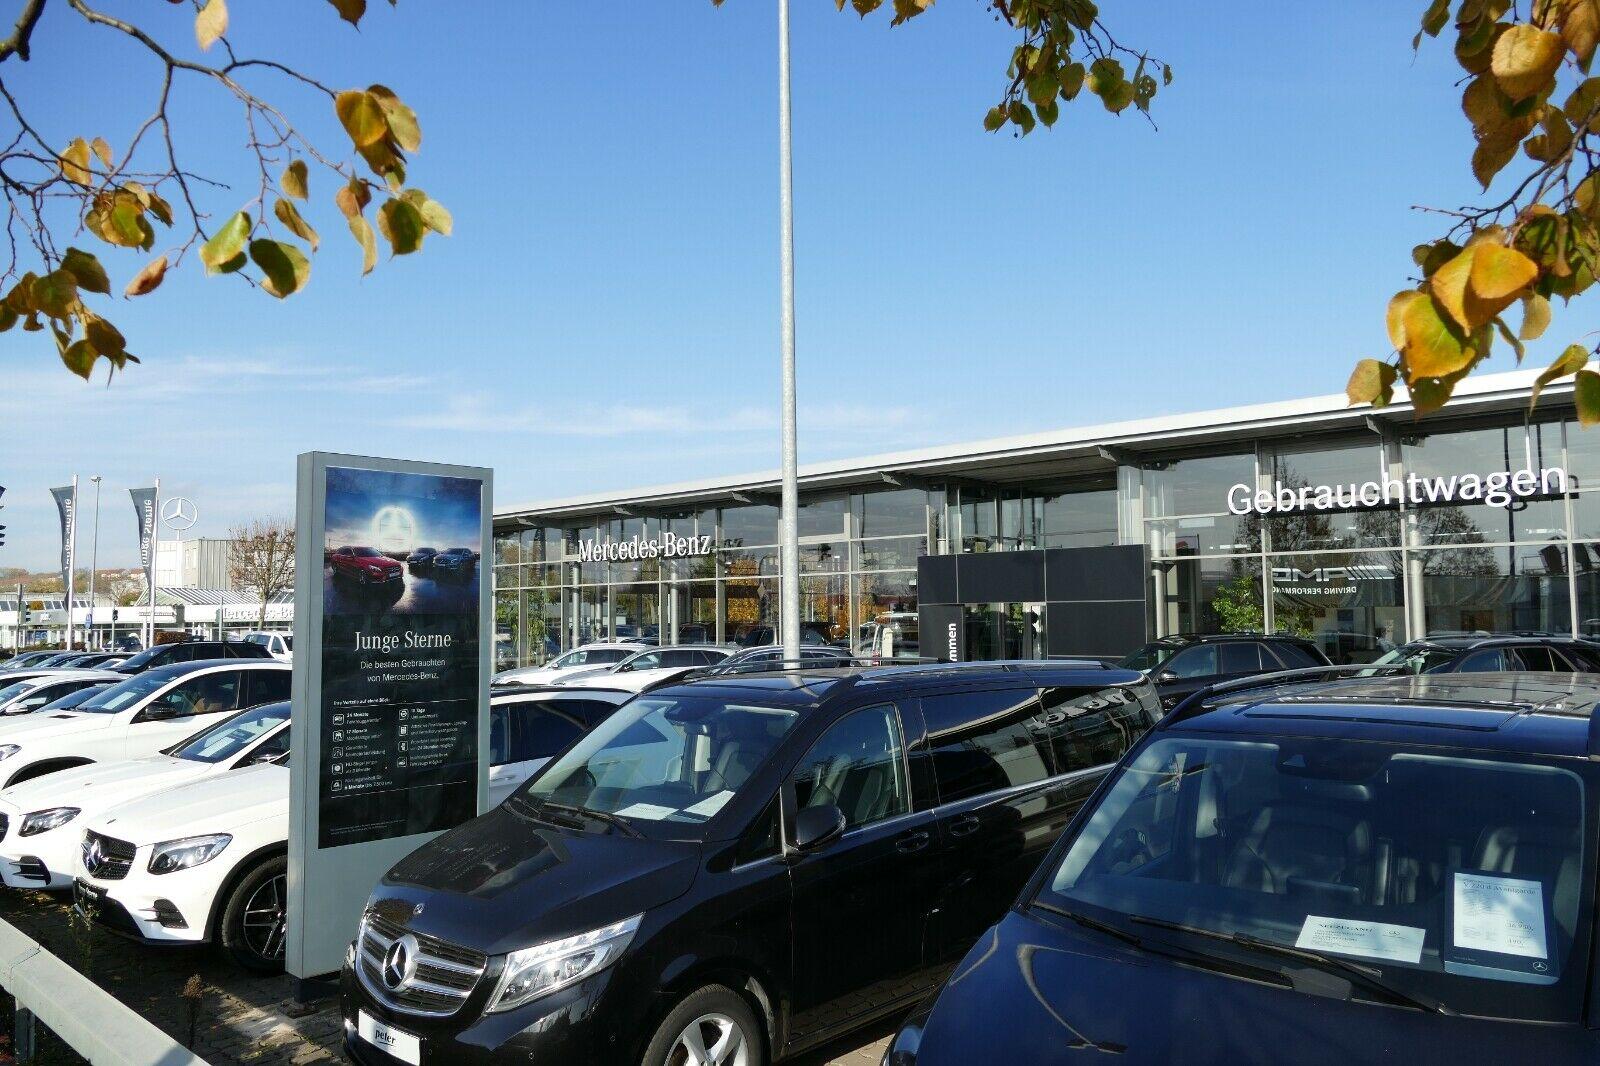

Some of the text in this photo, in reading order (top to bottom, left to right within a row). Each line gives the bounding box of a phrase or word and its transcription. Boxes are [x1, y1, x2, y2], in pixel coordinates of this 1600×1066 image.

[1227, 466, 1567, 515] Gebrauchtwagen
[577, 532, 711, 563] Mercedes-Benz
[354, 630, 452, 654] Junge Sterne
[948, 623, 958, 662] mmen
[360, 659, 446, 669] Die besten Gebrauchten
[375, 1029, 396, 1044] peter
